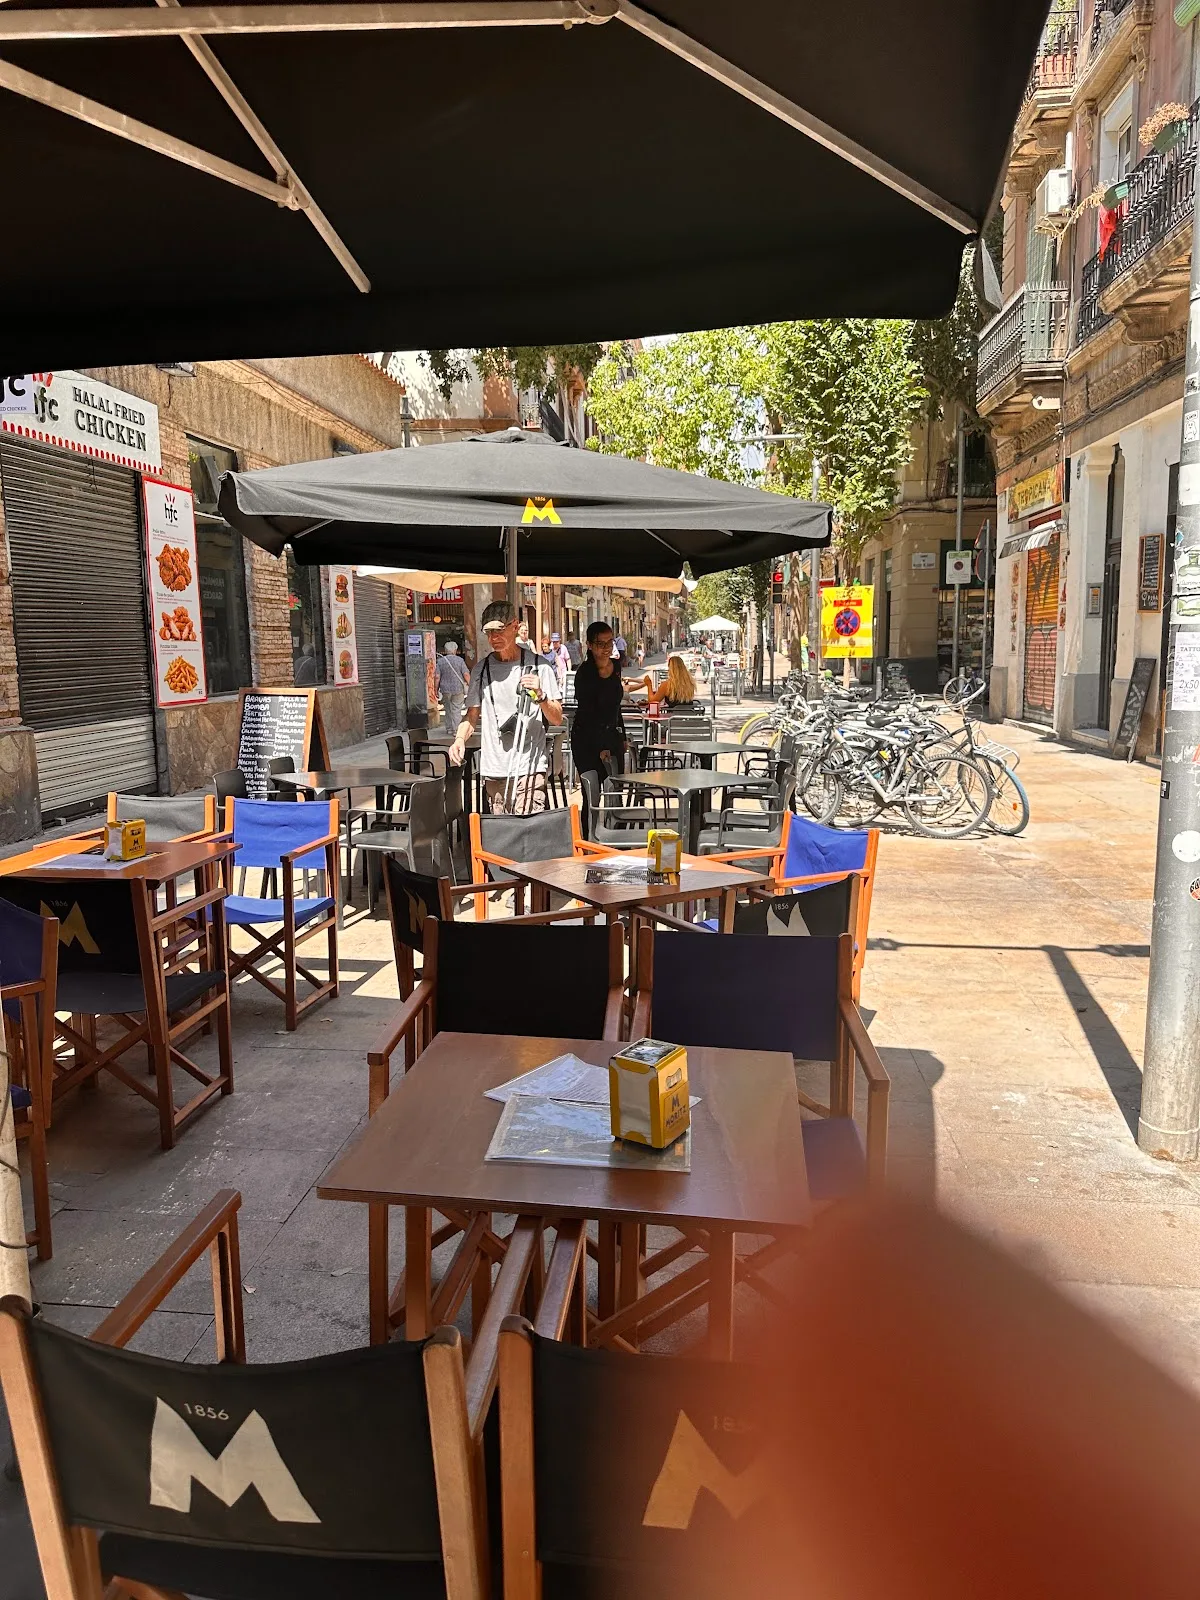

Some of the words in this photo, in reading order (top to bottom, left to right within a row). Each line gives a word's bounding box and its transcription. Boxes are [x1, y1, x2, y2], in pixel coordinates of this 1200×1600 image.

[72, 386, 113, 415] HALAL
[114, 401, 146, 426] FRIED
[75, 408, 147, 451] CHICKEN
[164, 503, 178, 524] hfc
[521, 498, 563, 525] M
[1178, 679, 1200, 690] 2x50
[774, 902, 790, 911] 1856
[671, 1094, 681, 1112] M
[665, 1104, 687, 1128] MORITZ
[184, 1402, 230, 1421] 1856
[149, 1395, 322, 1524] M
